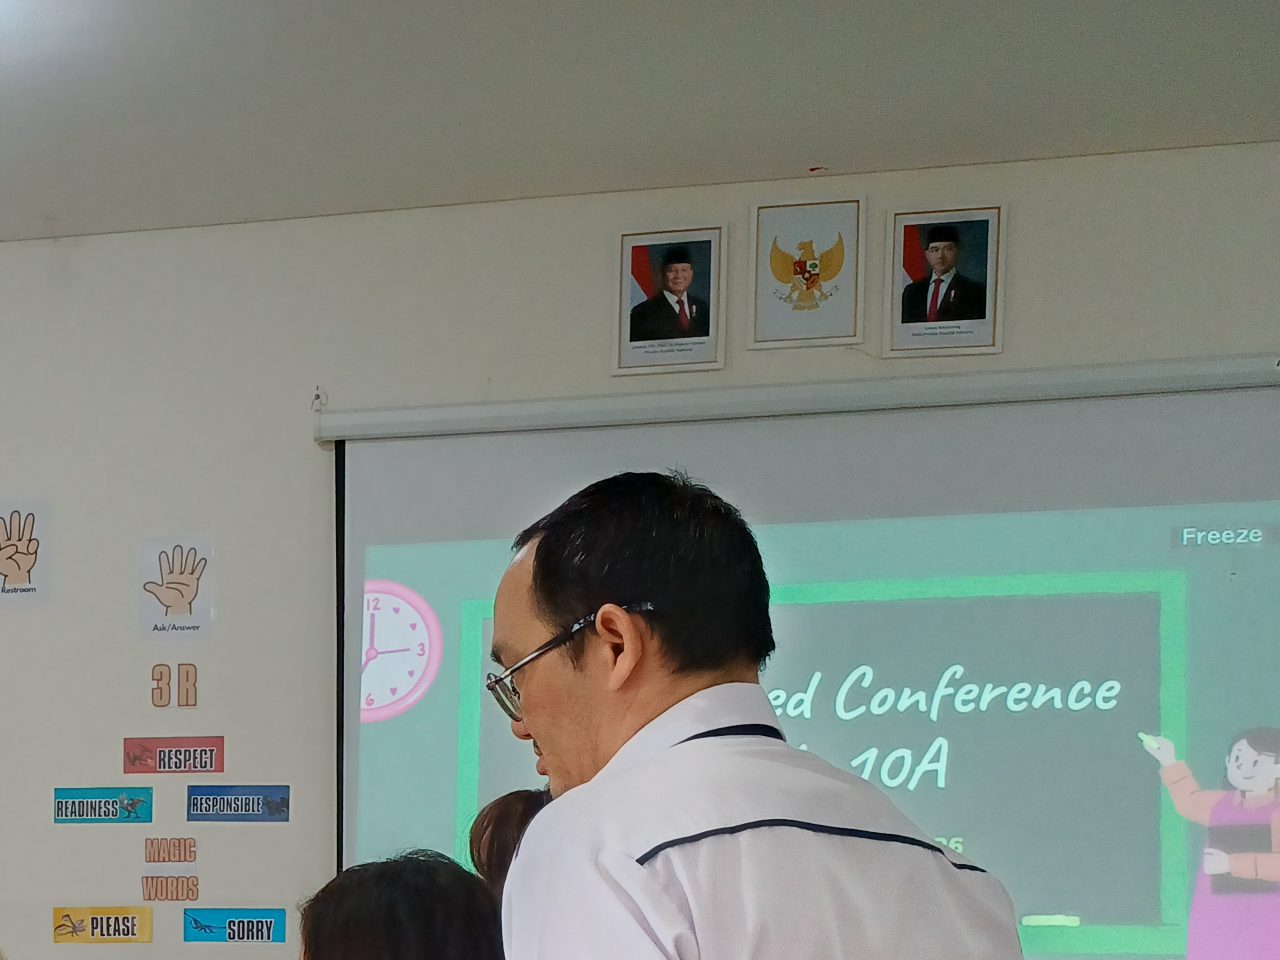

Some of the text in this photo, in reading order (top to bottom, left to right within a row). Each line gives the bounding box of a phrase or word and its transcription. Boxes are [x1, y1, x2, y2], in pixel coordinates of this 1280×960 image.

[1182, 527, 1263, 546] Freeze
[1, 586, 36, 594] Restroom
[366, 598, 382, 611] 12
[152, 623, 201, 632] Ask/Answer
[416, 642, 426, 657] 3
[365, 692, 375, 706] 6
[768, 664, 1121, 722] ed Conference
[157, 748, 215, 771] RESPECT
[850, 736, 949, 791] 10A
[56, 800, 119, 818] READINESS
[191, 796, 262, 814] RESPONSIBLE
[145, 837, 196, 863] MAGIC
[142, 876, 199, 901] WORDS
[90, 916, 137, 937] PLEASE
[227, 919, 274, 941] SORRY
